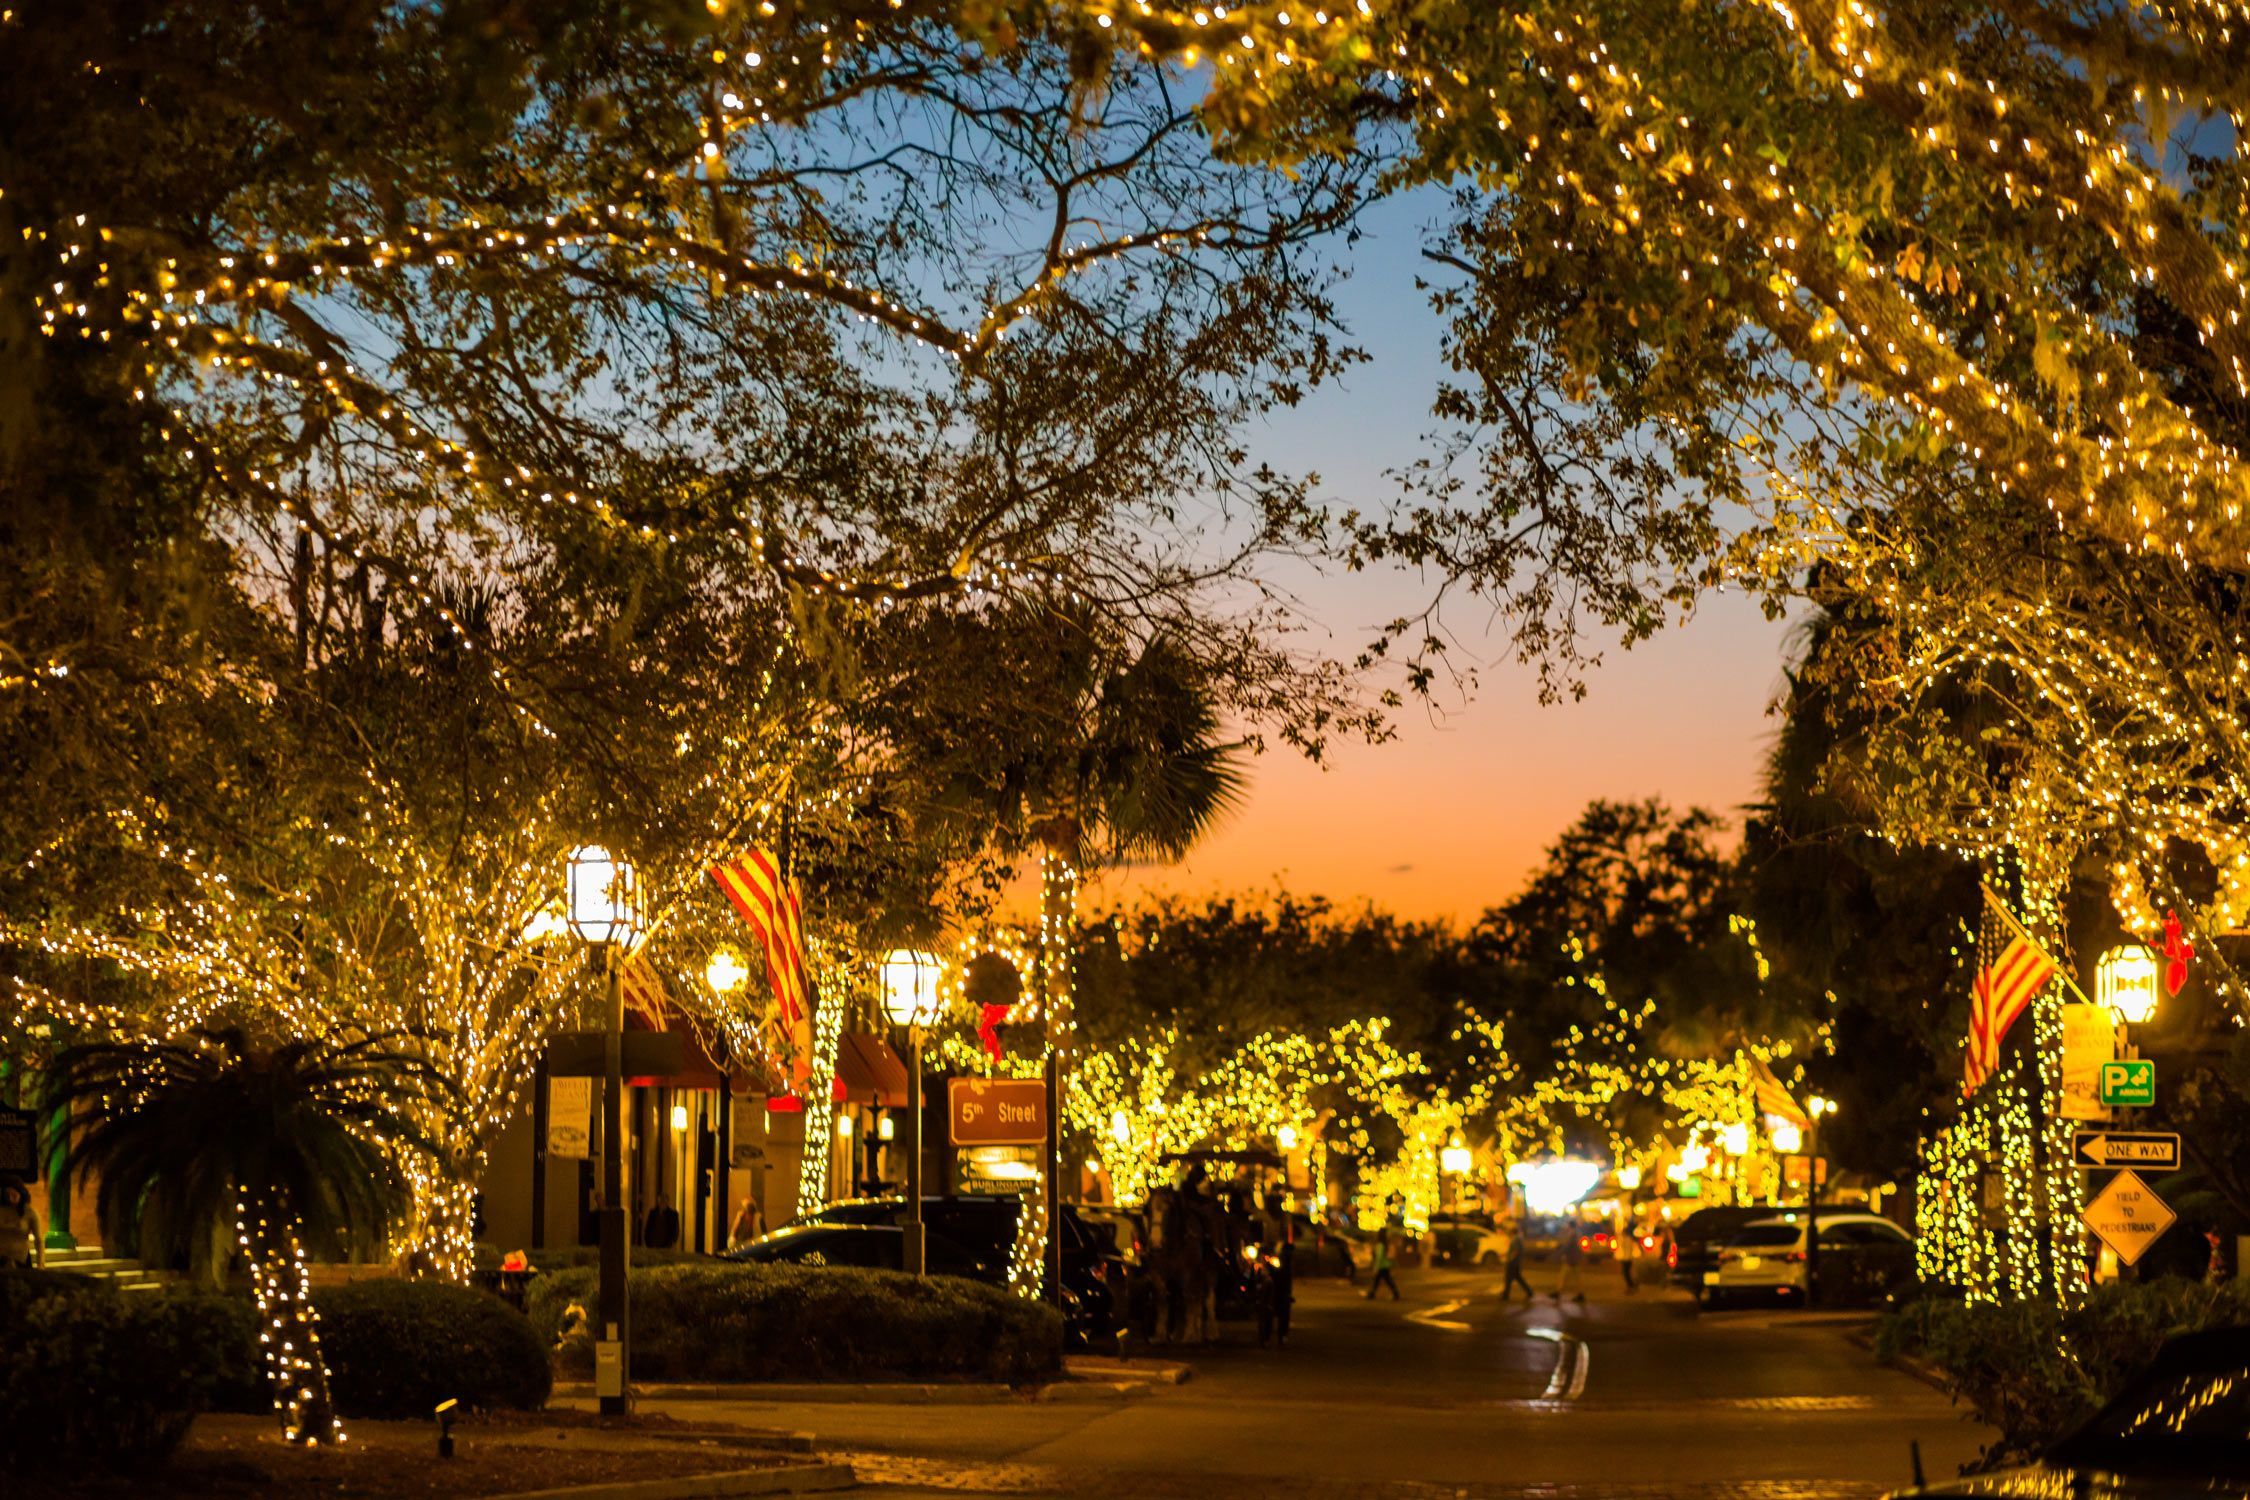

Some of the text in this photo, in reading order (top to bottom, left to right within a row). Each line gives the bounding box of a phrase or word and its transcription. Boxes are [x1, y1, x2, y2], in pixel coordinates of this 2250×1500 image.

[962, 1102, 1036, 1123] 5th Street
[2106, 1143, 2167, 1157] ONE WAY
[2115, 1191, 2141, 1202] YIELD
[2122, 1207, 2134, 1218] TO
[2100, 1222, 2157, 1233] PEDESTRIANS
